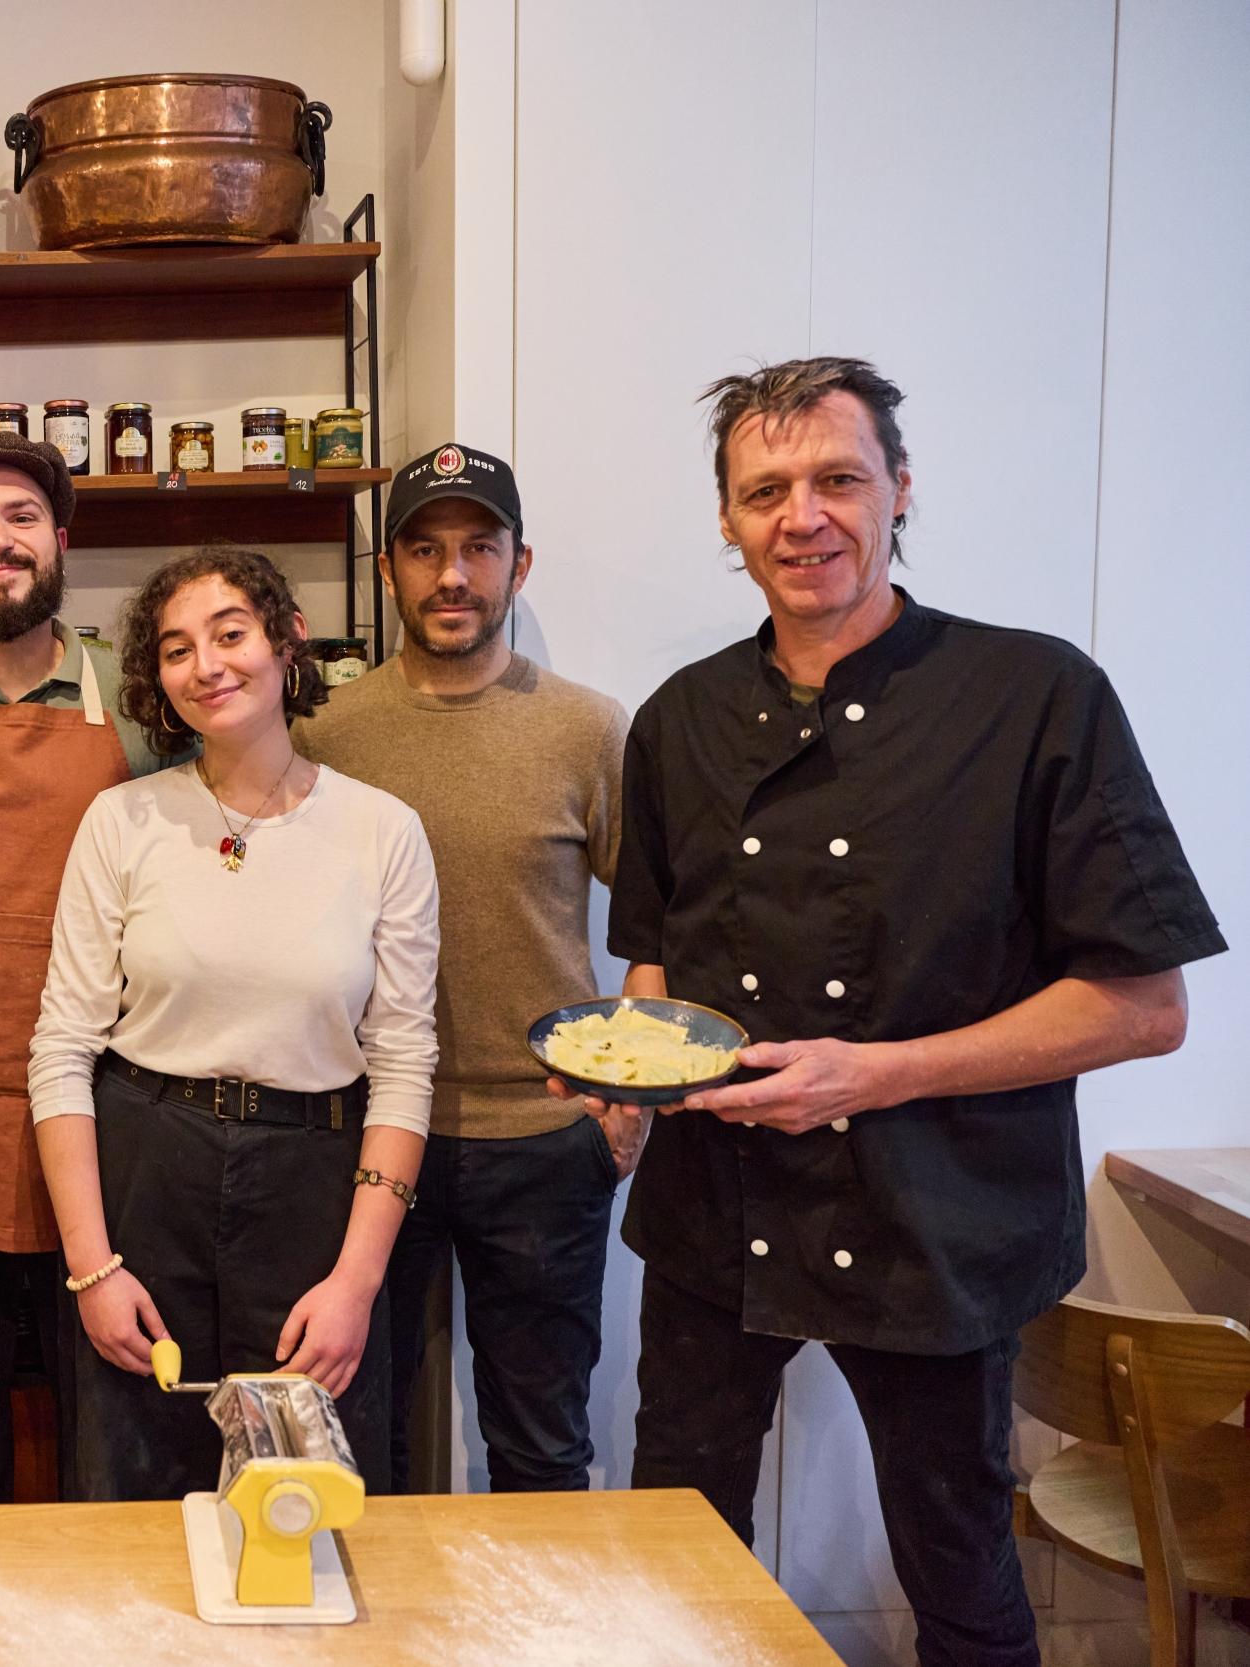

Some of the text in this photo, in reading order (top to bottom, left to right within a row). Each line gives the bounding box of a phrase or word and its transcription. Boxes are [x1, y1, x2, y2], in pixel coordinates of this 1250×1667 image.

[409, 458, 495, 480] EST. 1899
[166, 480, 178, 488] 20
[295, 480, 307, 490] 12
